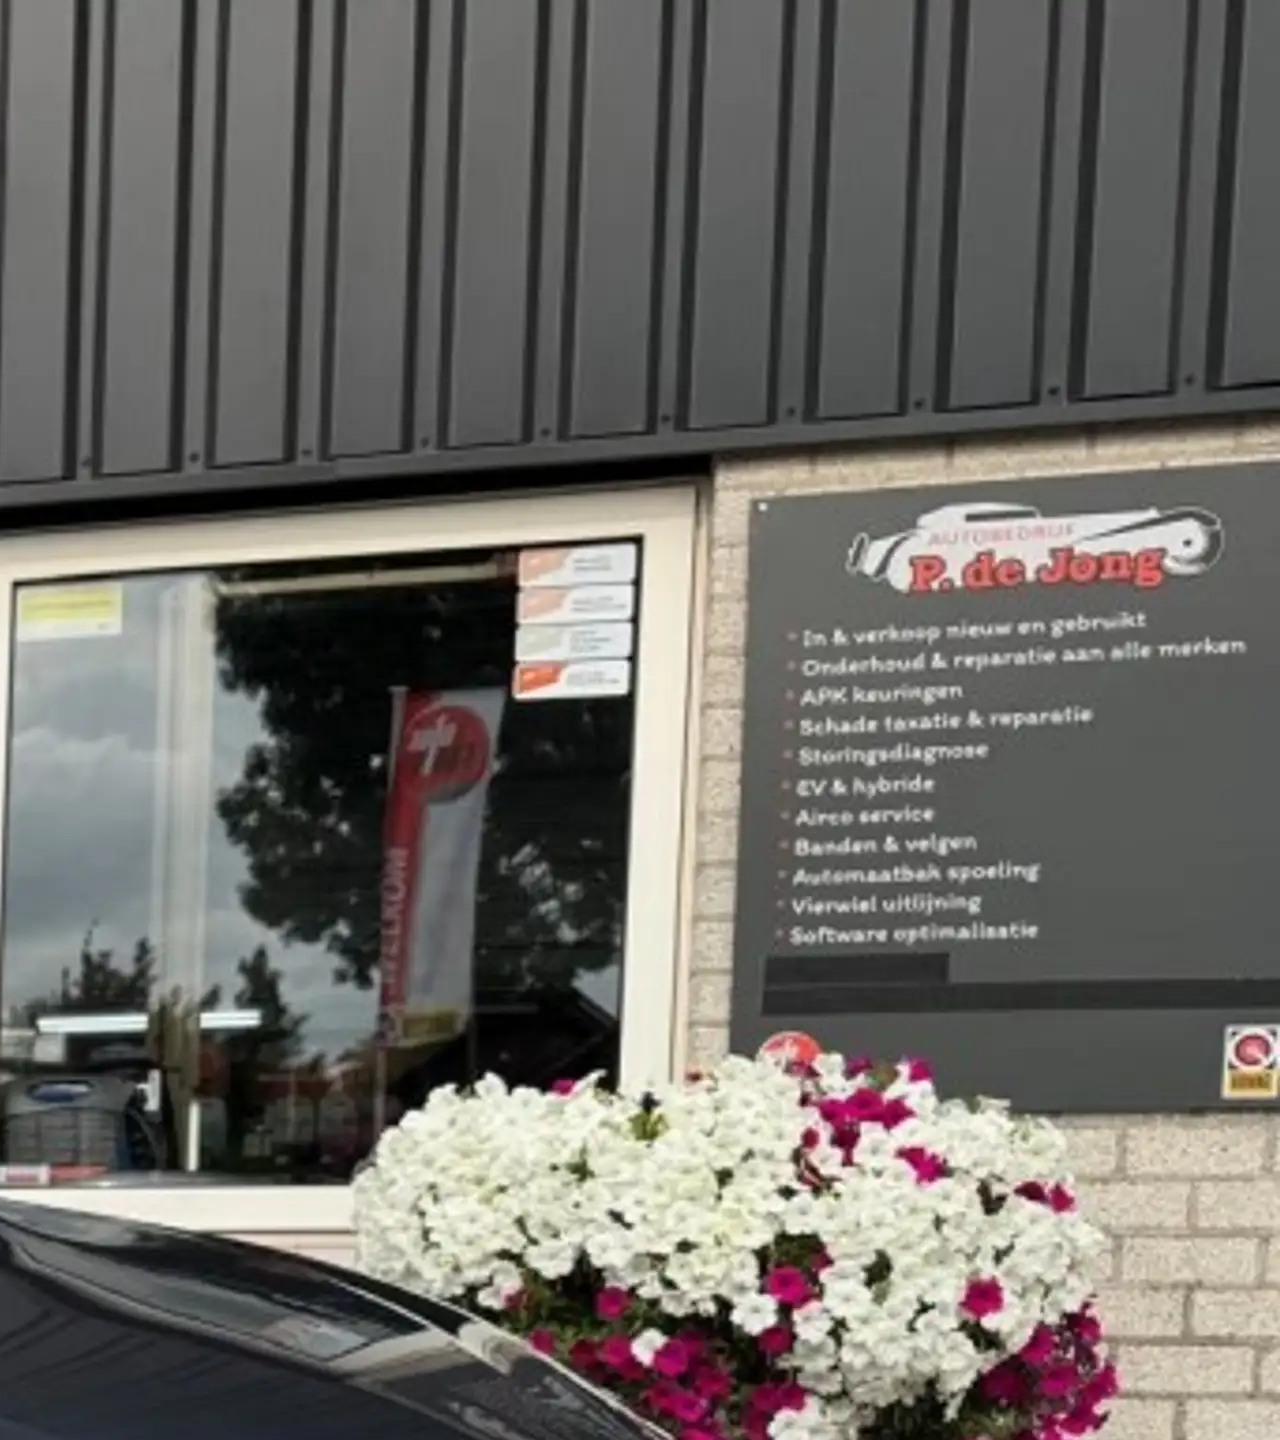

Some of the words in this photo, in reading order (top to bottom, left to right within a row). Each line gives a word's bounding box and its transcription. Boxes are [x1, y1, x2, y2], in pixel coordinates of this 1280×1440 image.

[909, 553, 954, 593] P.
[962, 549, 1026, 590] de
[1037, 545, 1168, 588] Jong
[802, 628, 828, 648] In
[831, 627, 850, 646] &
[852, 624, 941, 646] verkoop
[946, 619, 1012, 639] nieuw
[1017, 620, 1046, 636] en
[1050, 611, 1147, 639] gebruikt
[801, 652, 925, 677] Onderhoud
[931, 652, 949, 669] &
[953, 646, 1056, 673] reparatie
[1061, 648, 1106, 662] aan
[1110, 640, 1153, 662] alle
[1157, 636, 1247, 658] merken
[799, 685, 848, 707] APK
[852, 683, 965, 707] keuringen
[799, 716, 879, 737] Schade
[884, 711, 962, 733] taxatie
[967, 708, 984, 728] &
[989, 704, 1094, 730] reparatie
[798, 742, 989, 768] Storingsdiagnose
[795, 777, 828, 798] EV
[830, 777, 849, 796] &
[852, 773, 936, 799] hybride
[795, 808, 854, 827] Airco
[859, 804, 936, 824] service
[793, 836, 878, 857] Banden
[883, 835, 901, 853] &
[904, 832, 978, 857] velgen
[792, 862, 942, 886] Automaatbak
[946, 860, 1041, 884] spoeling
[791, 894, 878, 916] Vierwiel
[882, 891, 983, 916] uitlijning
[788, 924, 890, 946] Software
[893, 920, 1039, 946] optimalisatie
